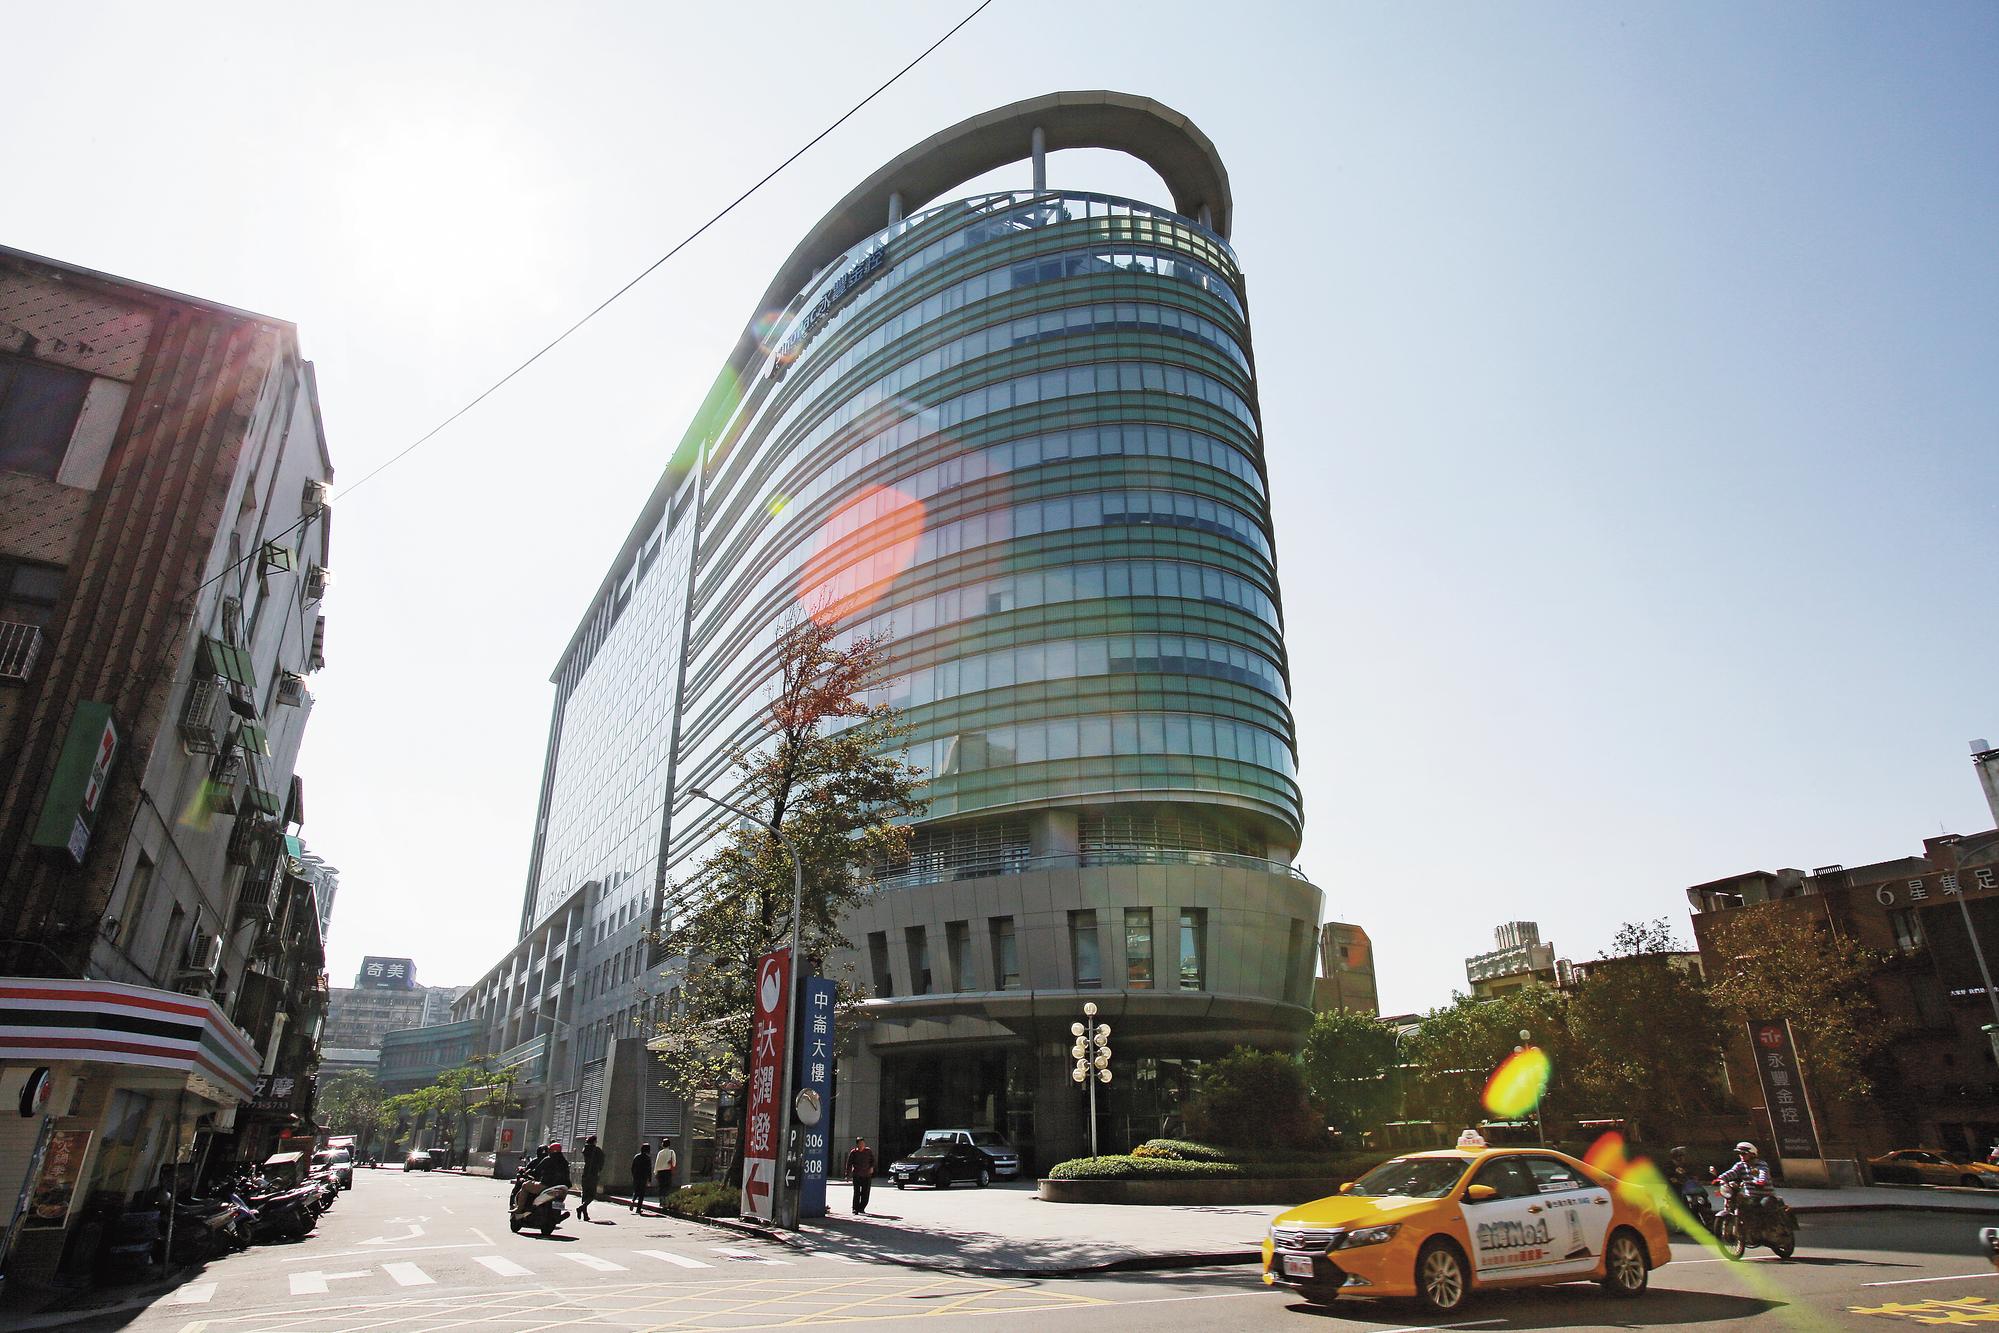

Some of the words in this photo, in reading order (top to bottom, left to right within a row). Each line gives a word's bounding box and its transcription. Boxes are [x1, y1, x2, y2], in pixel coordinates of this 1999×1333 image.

[367, 963, 405, 978] 奇美
[811, 991, 828, 1083] 中崙大樓
[757, 1020, 778, 1151] 大潤發
[1768, 1053, 1799, 1122] 永豐金控
[805, 1134, 823, 1147] 306
[804, 1160, 822, 1173] 308
